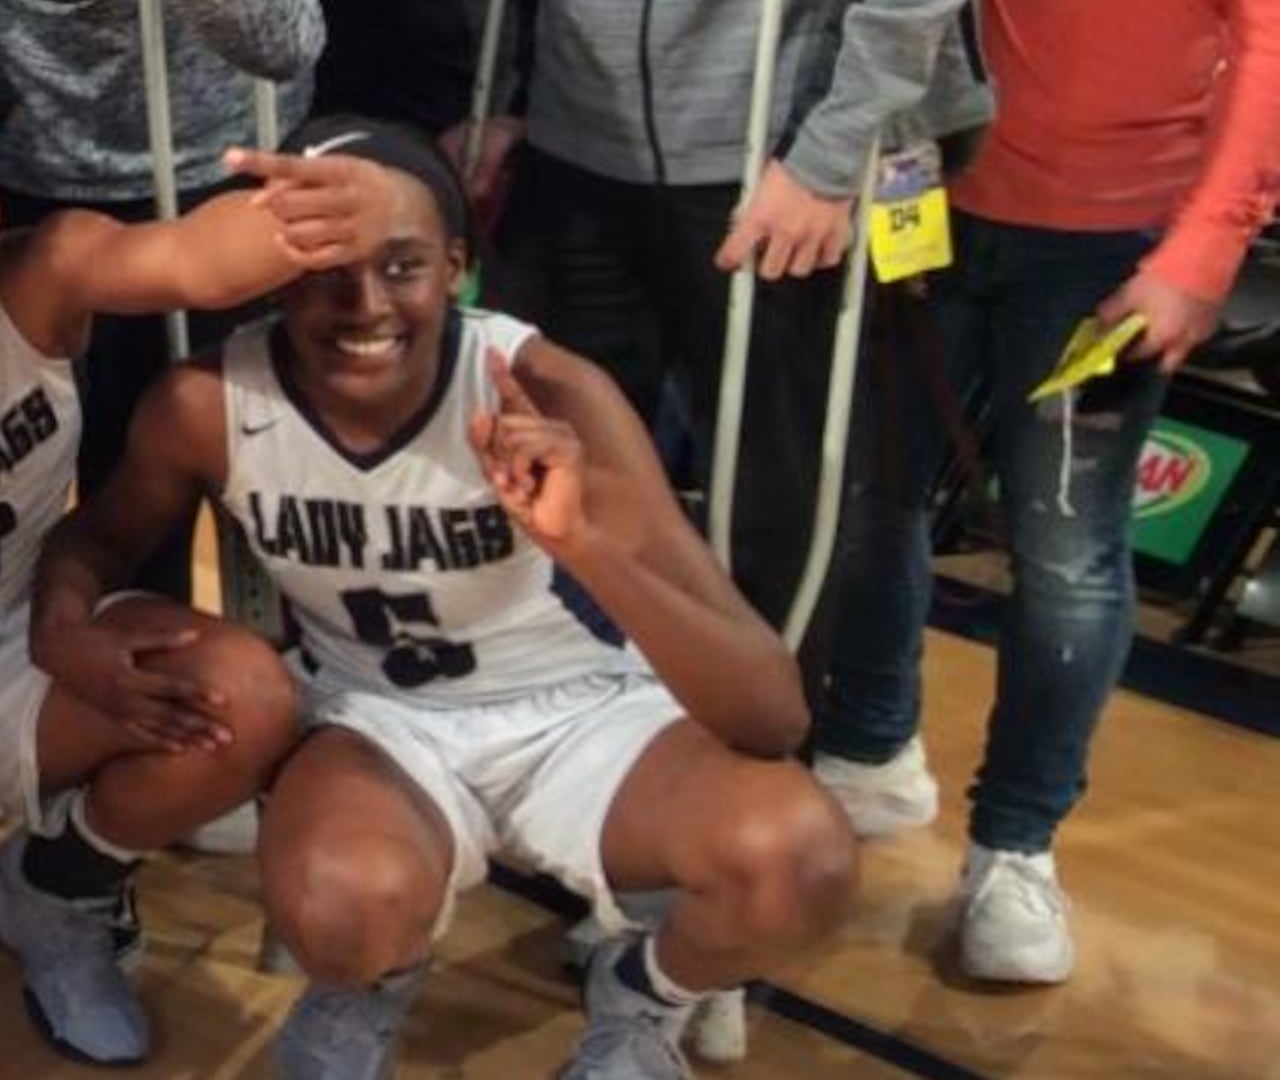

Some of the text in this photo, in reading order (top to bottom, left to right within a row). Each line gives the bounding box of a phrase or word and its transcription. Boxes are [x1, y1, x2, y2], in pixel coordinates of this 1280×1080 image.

[248, 491, 515, 572] LADY JAGS
[338, 585, 478, 689] 5
